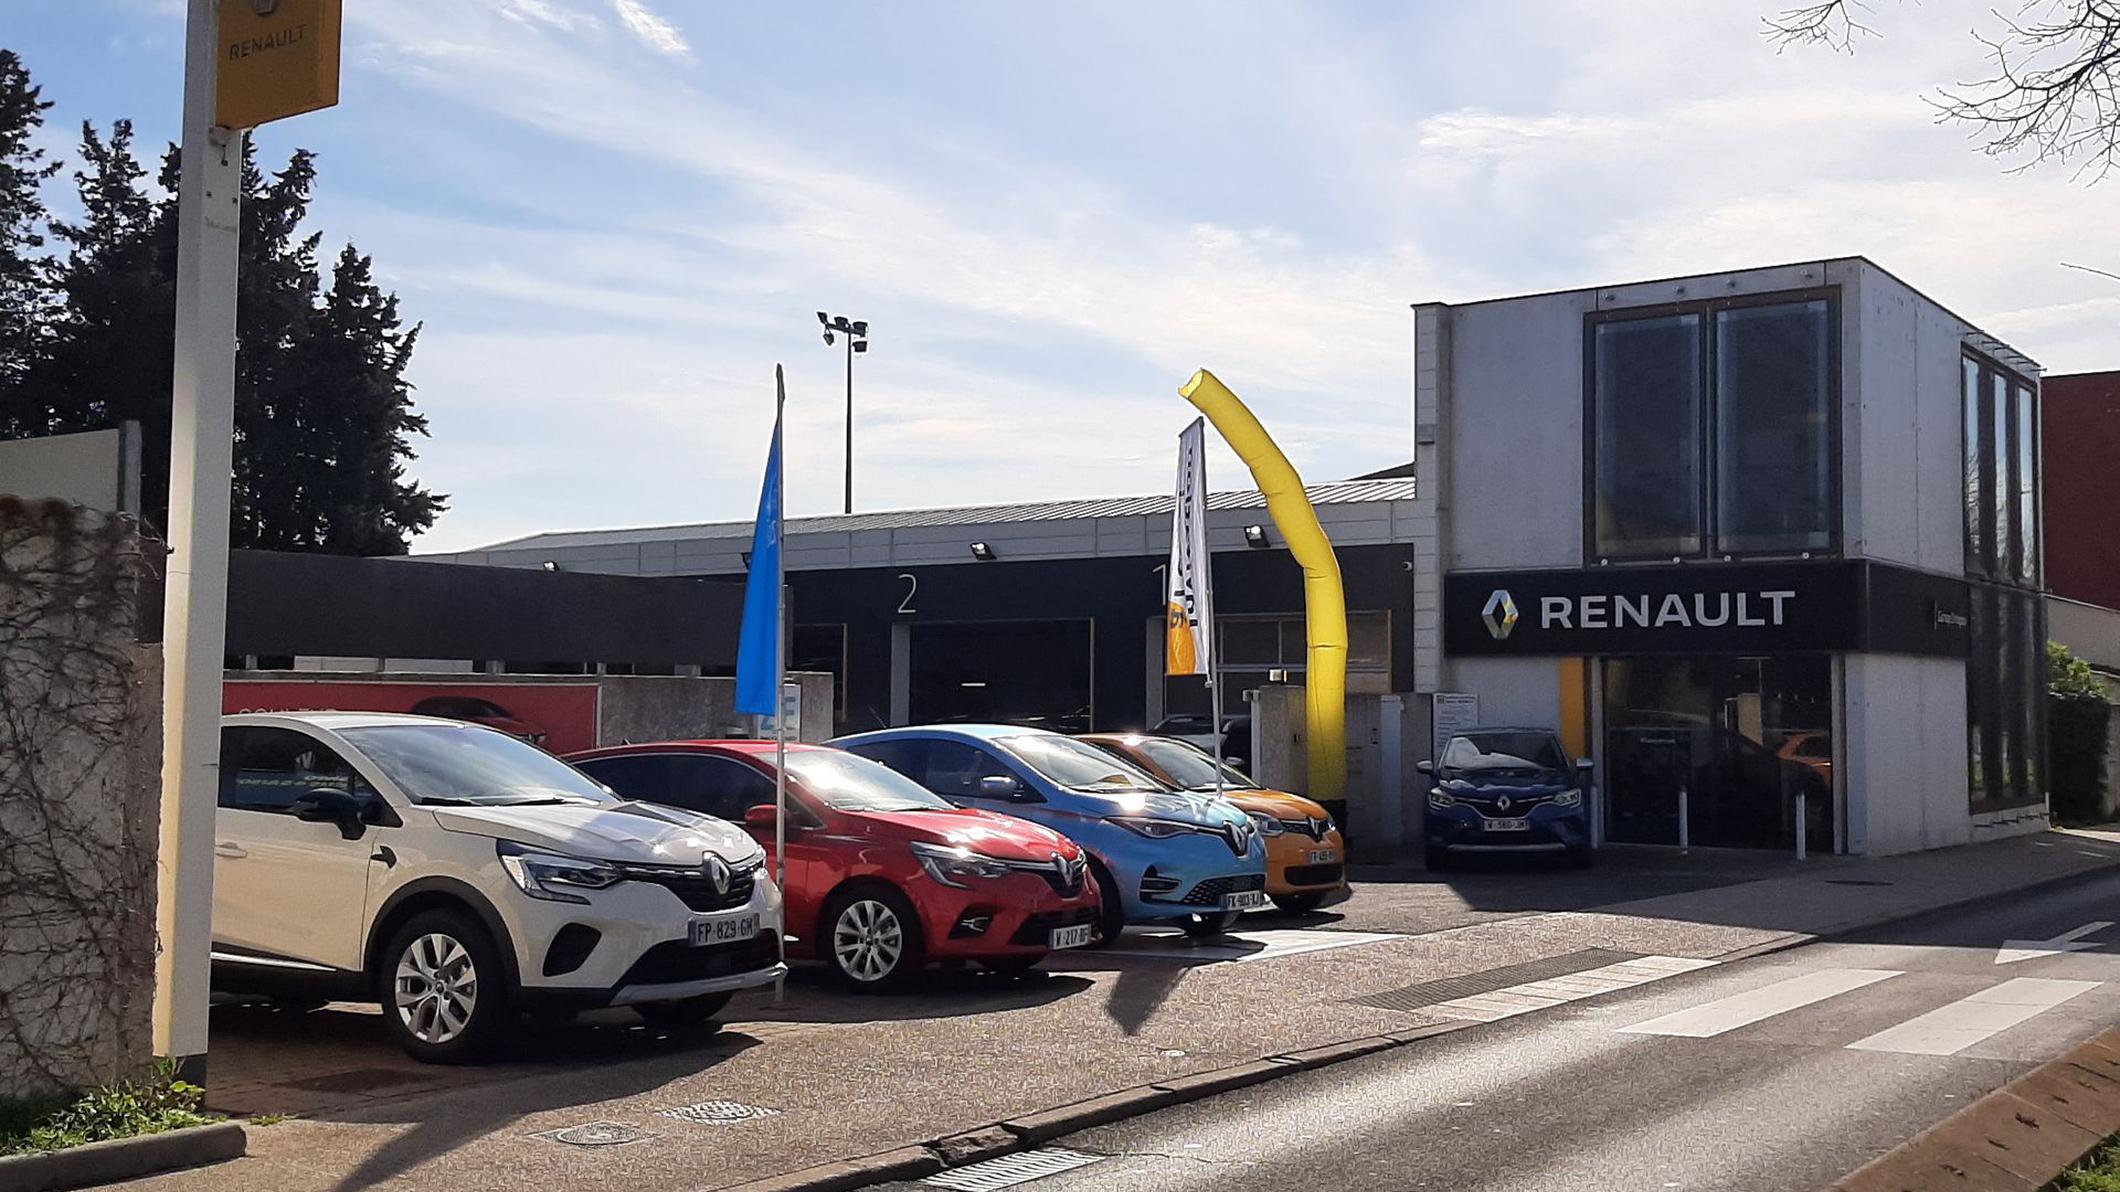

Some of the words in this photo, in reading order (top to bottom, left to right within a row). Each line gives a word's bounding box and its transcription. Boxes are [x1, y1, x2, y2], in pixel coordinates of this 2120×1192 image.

[229, 23, 307, 61] RENAULT
[896, 573, 919, 614] 2
[1153, 563, 1167, 606] 1
[1540, 590, 1796, 629] RENAULT
